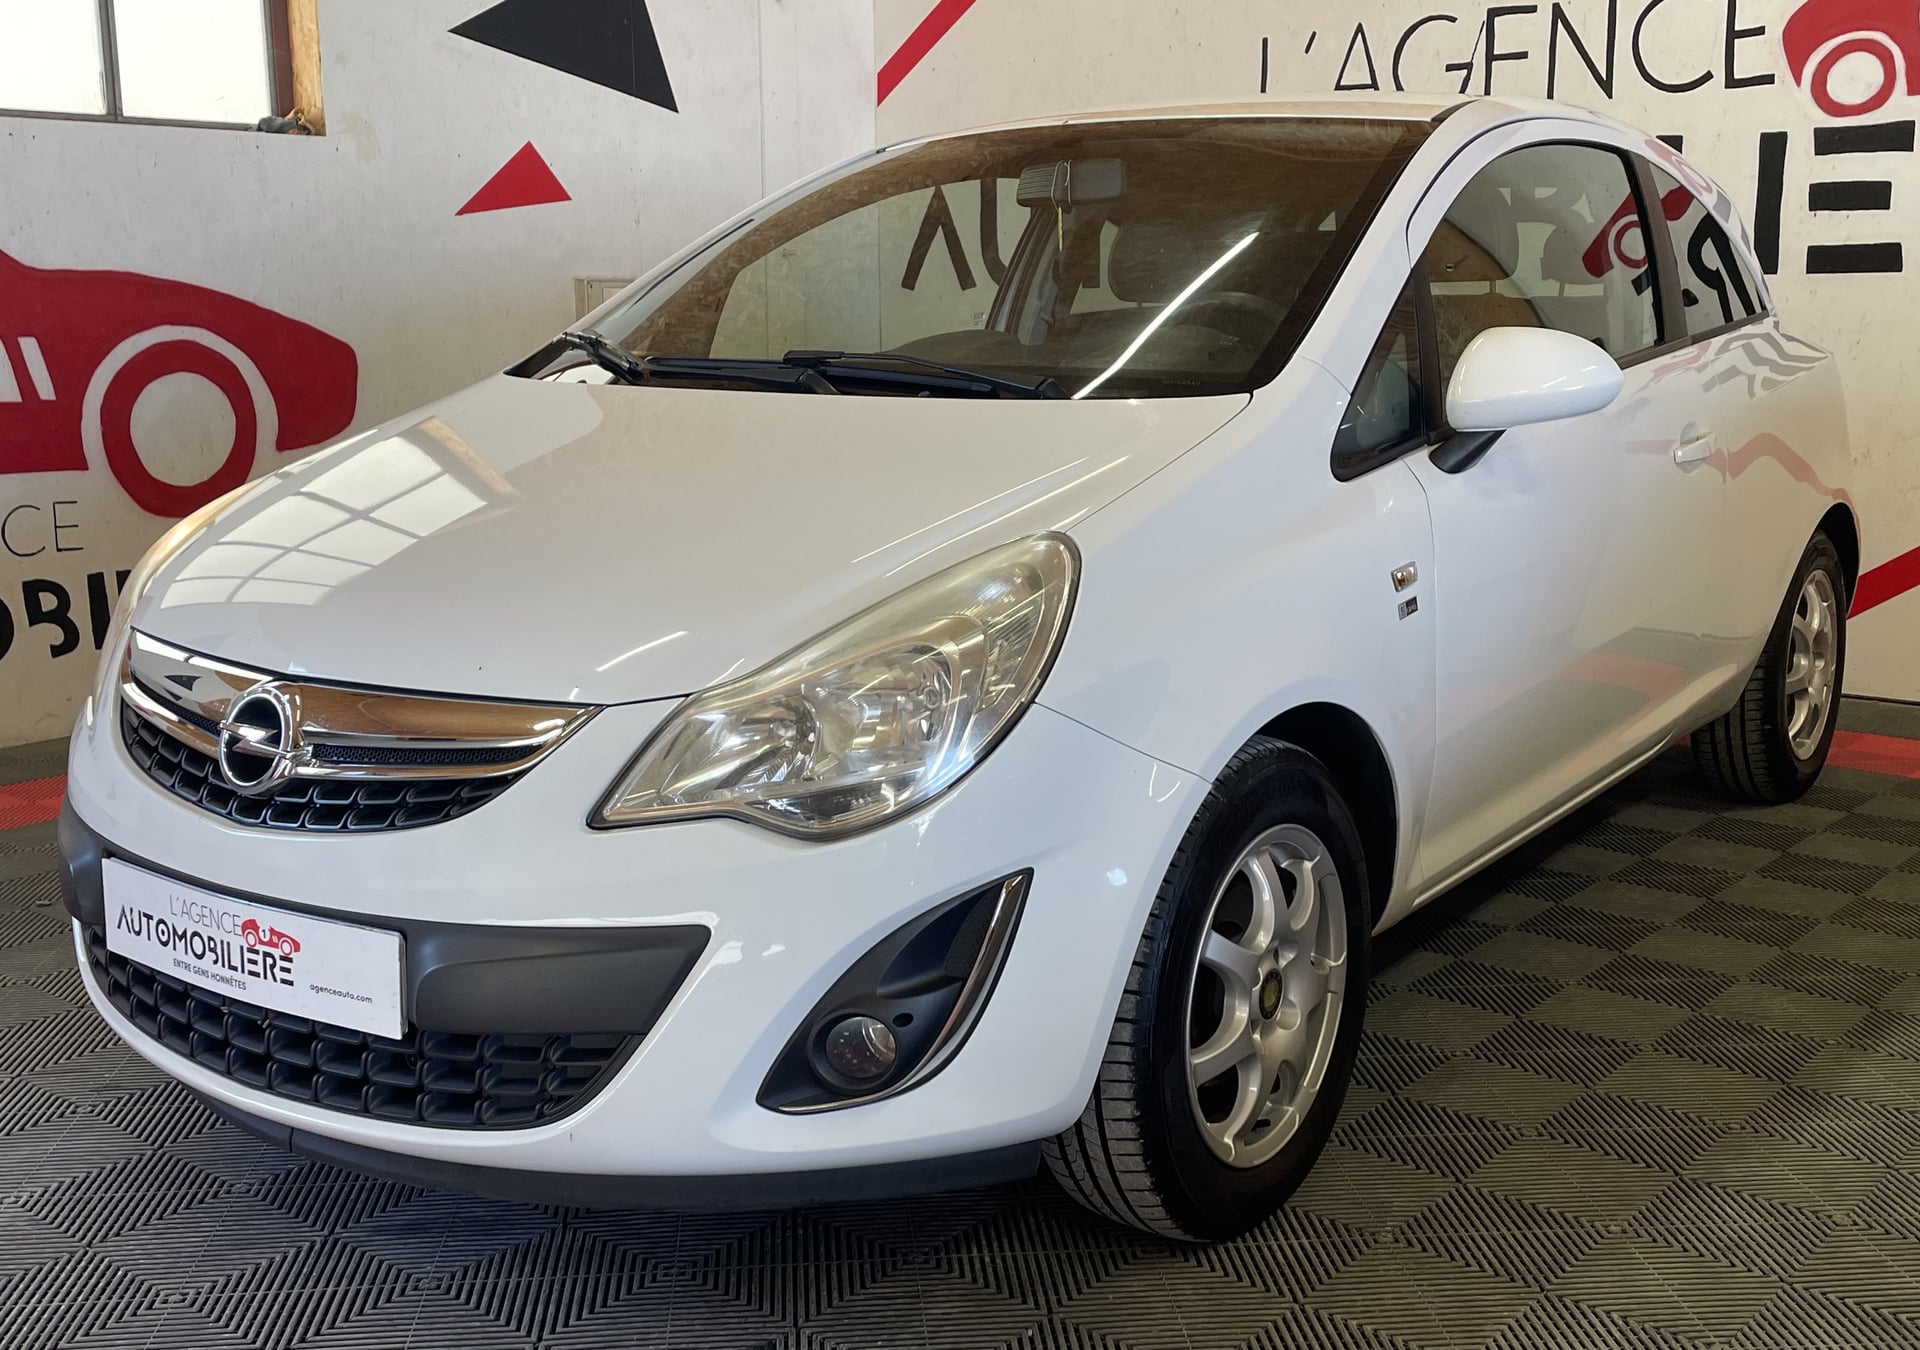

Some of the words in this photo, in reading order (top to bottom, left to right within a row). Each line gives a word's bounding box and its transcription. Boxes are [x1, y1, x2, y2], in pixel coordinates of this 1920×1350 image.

[169, 894, 242, 937] L'AGENCE
[173, 958, 192, 973] ENTRE
[192, 965, 210, 979] GENS
[210, 971, 247, 991] HONNÊTES
[309, 983, 373, 1004] agenceauto.com
